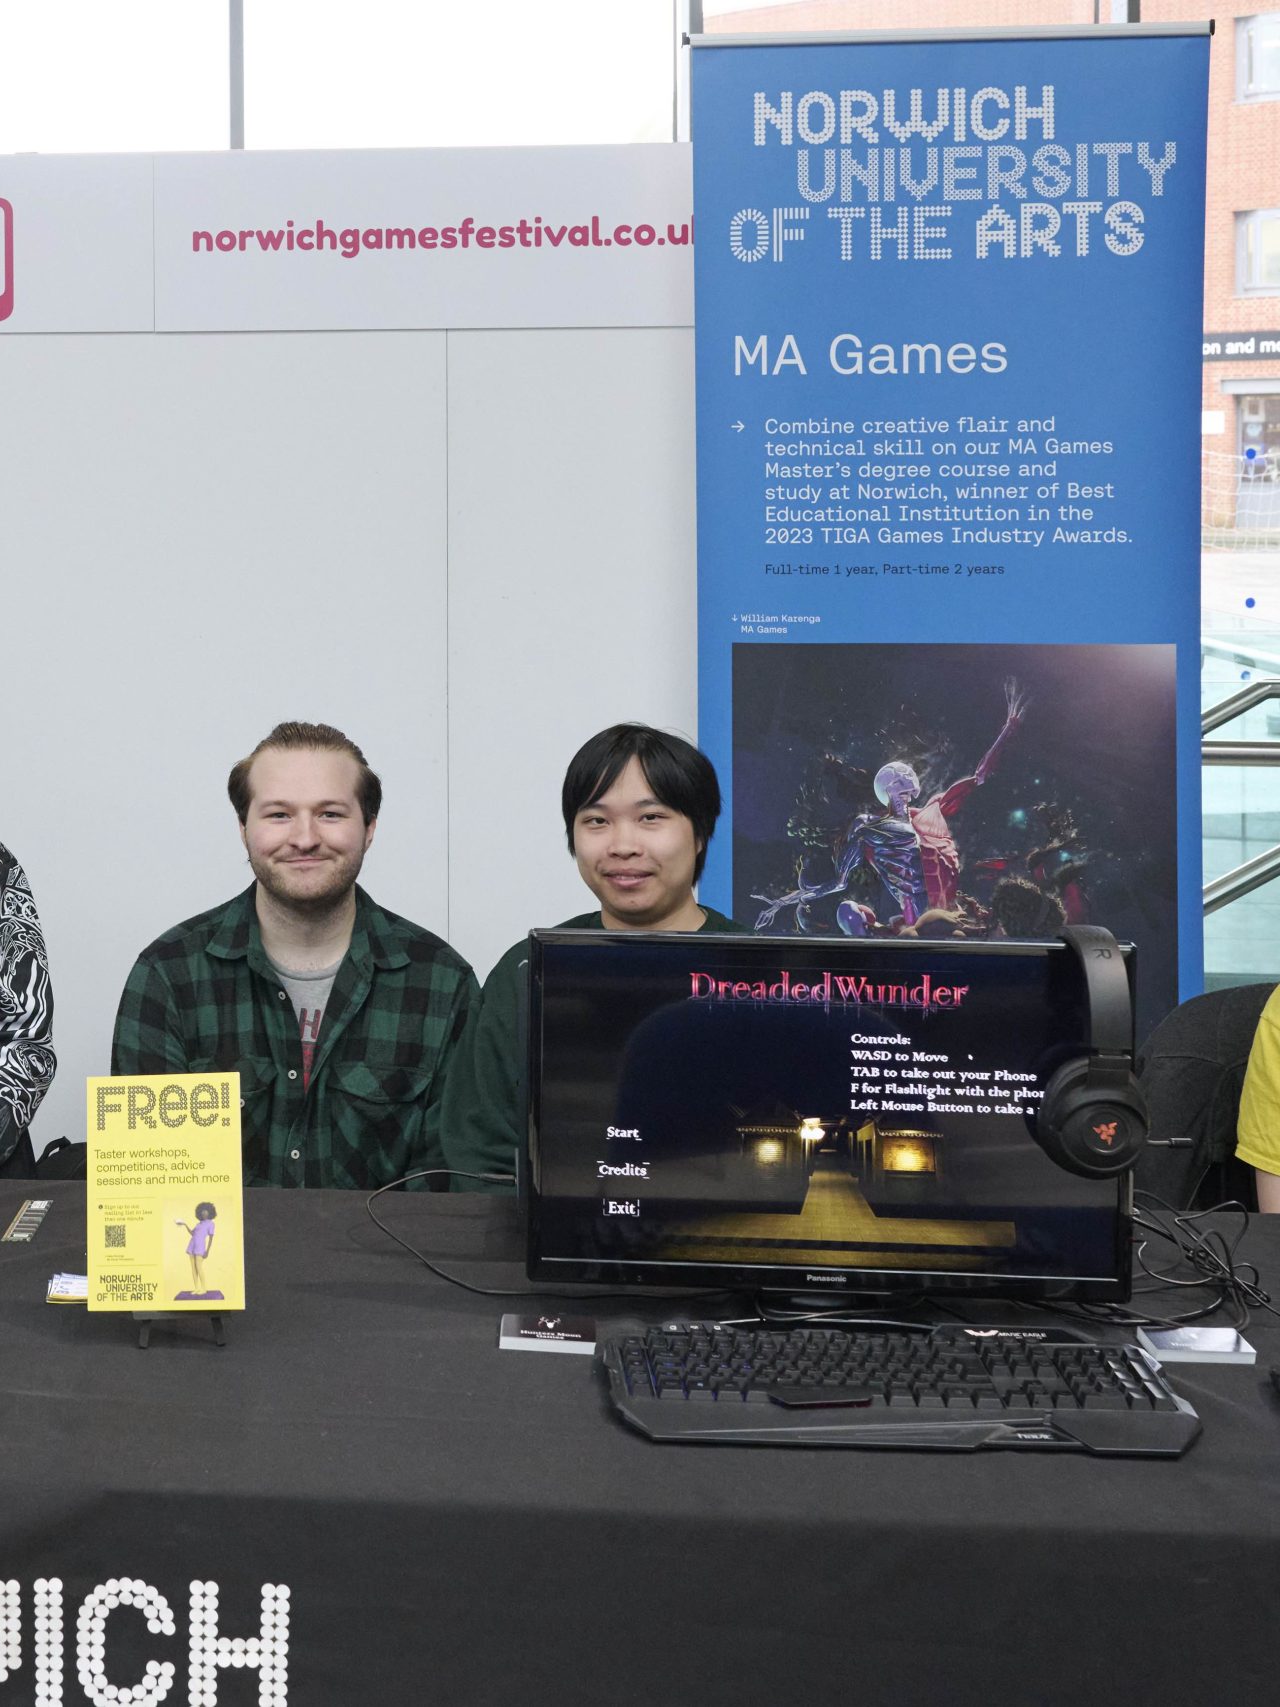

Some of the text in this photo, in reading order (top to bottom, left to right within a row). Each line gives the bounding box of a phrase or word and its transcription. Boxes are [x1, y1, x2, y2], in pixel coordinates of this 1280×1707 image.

[753, 84, 1055, 146] NORWICH
[797, 141, 1177, 203] UNIVERSITY
[192, 214, 694, 259] norwichgamesfestival.co.u
[729, 200, 1145, 263] OF THE ARTS
[1225, 337, 1256, 354] and
[735, 334, 1008, 376] MA Games
[765, 416, 1055, 434] Combine creative flair and
[764, 438, 1113, 456] technical skill on our MA Games
[765, 460, 1057, 481] Master’s degree course and
[765, 481, 1115, 503] study at Norwich, winner of Best
[765, 503, 1094, 523] Educational Institution in the
[765, 526, 1133, 547] 2023 TIGA Games Industry Awards.
[765, 563, 1005, 577] Full-time 1 year, Part-time 2 years
[741, 613, 821, 624] William Karenga
[741, 625, 788, 634] MA Games
[850, 1033, 911, 1045] Controls:
[850, 1050, 949, 1063] WASD to Move
[850, 1066, 1037, 1083] TAB to take out your Phone
[850, 1082, 1011, 1100] F for Flashlight with the
[850, 1099, 1034, 1115] Left Mouse Button to take a
[606, 1126, 640, 1138] Start
[94, 1148, 190, 1160] Taster workshops,
[96, 1160, 205, 1174] competitions, advice
[598, 1163, 647, 1176] Credits
[96, 1173, 230, 1186] sessions and much more
[608, 1201, 636, 1215] Exit
[100, 1275, 141, 1283] NORWICH
[806, 1274, 847, 1282] Panasonic
[106, 1283, 158, 1292] UNIVERSITY
[97, 1292, 153, 1301] OF THE ARTS
